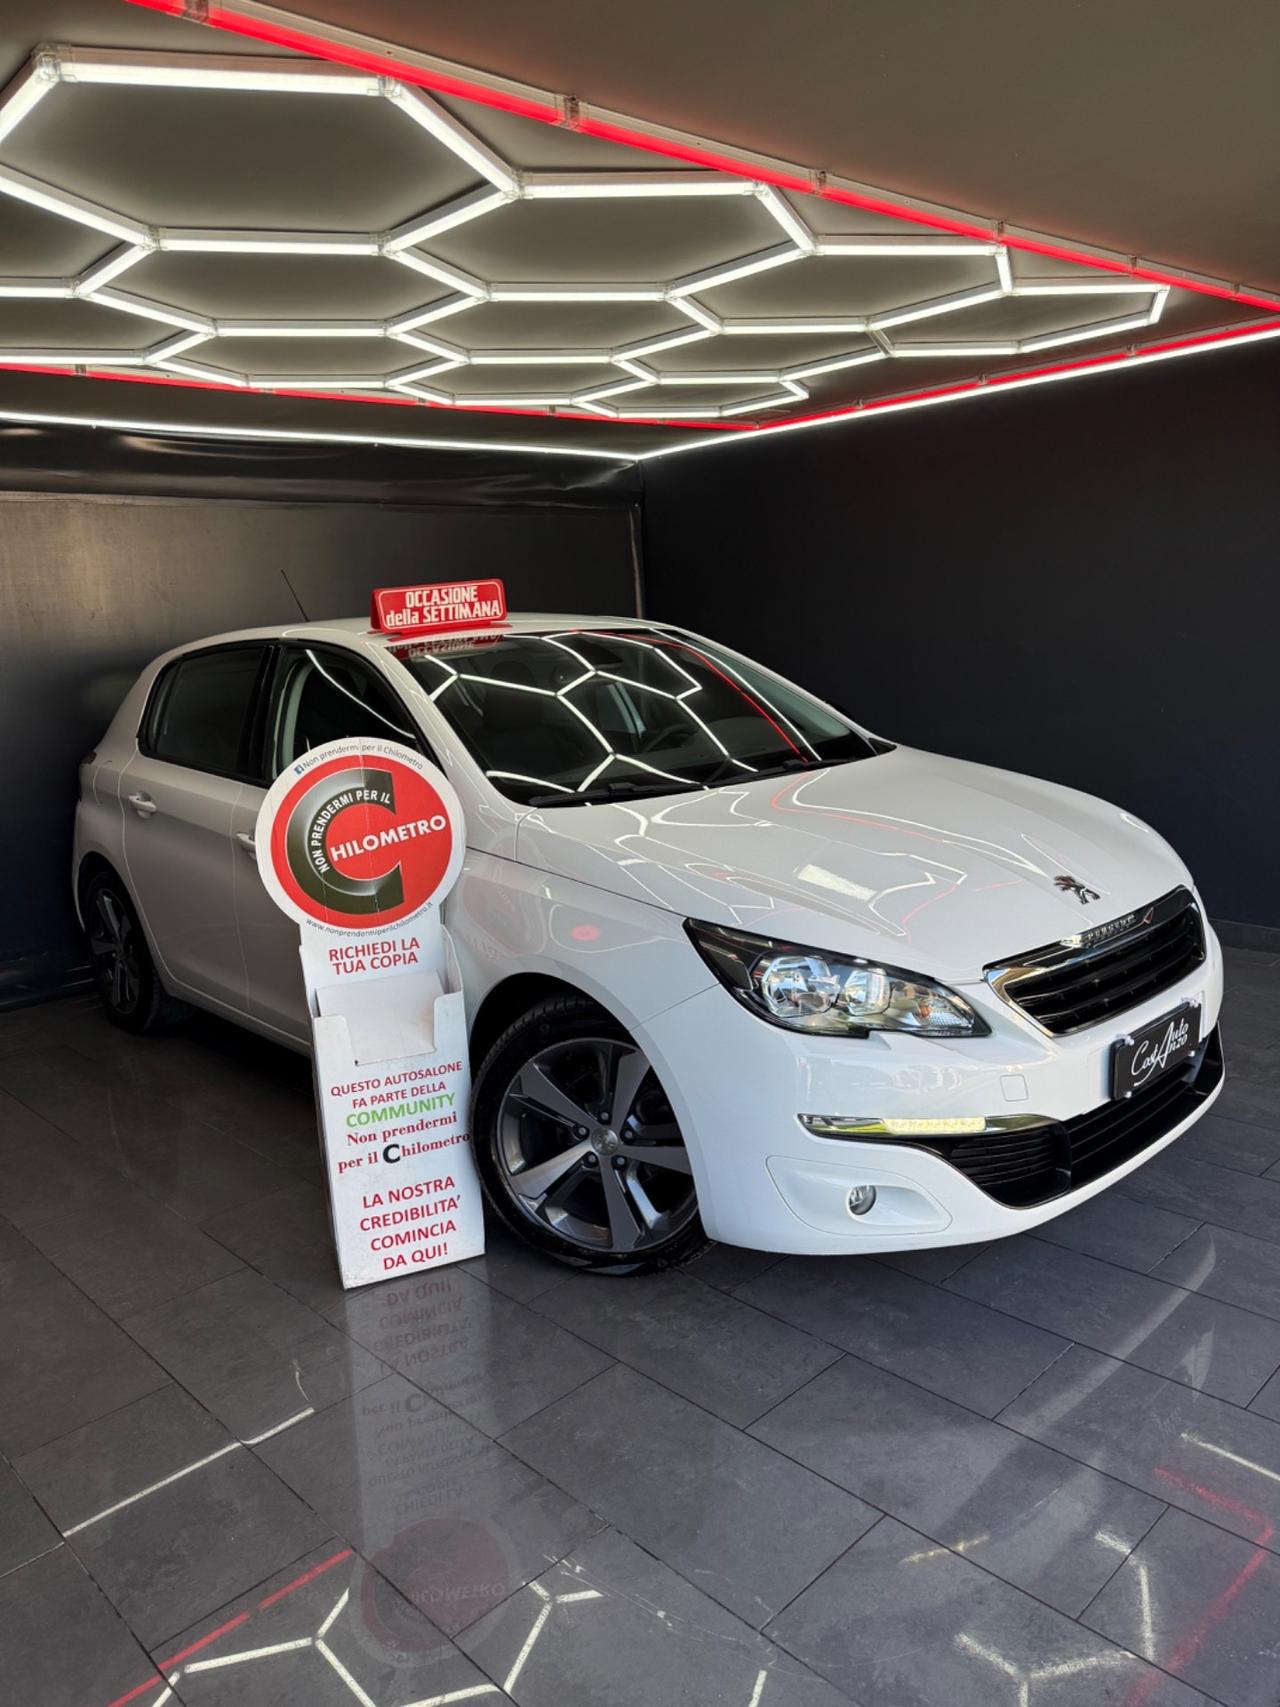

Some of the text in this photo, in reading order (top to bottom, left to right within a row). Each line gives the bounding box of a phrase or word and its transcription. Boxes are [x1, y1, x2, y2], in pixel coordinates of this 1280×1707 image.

[405, 585, 478, 608] OCCASIONE
[386, 600, 501, 626] della SETTIMANA
[302, 756, 320, 769] Non
[377, 744, 383, 752] il
[384, 746, 423, 770] Chilometro
[312, 789, 392, 873] NON PRENDERMI PER IL
[328, 937, 420, 962] RICHIEDI LA
[332, 952, 419, 976] TUA COPIA
[331, 1061, 463, 1097] QUESTO AUTOSALONE
[346, 1092, 456, 1128] COMMUNITY
[352, 1081, 446, 1109] FA PARTE DELLA
[346, 1111, 457, 1146] Non prendermi
[337, 1132, 471, 1173] per il Chilometro
[363, 1176, 456, 1209] LA NOSTRA
[370, 1219, 456, 1251] COMINCIA
[383, 1242, 448, 1270] DA QUI!
